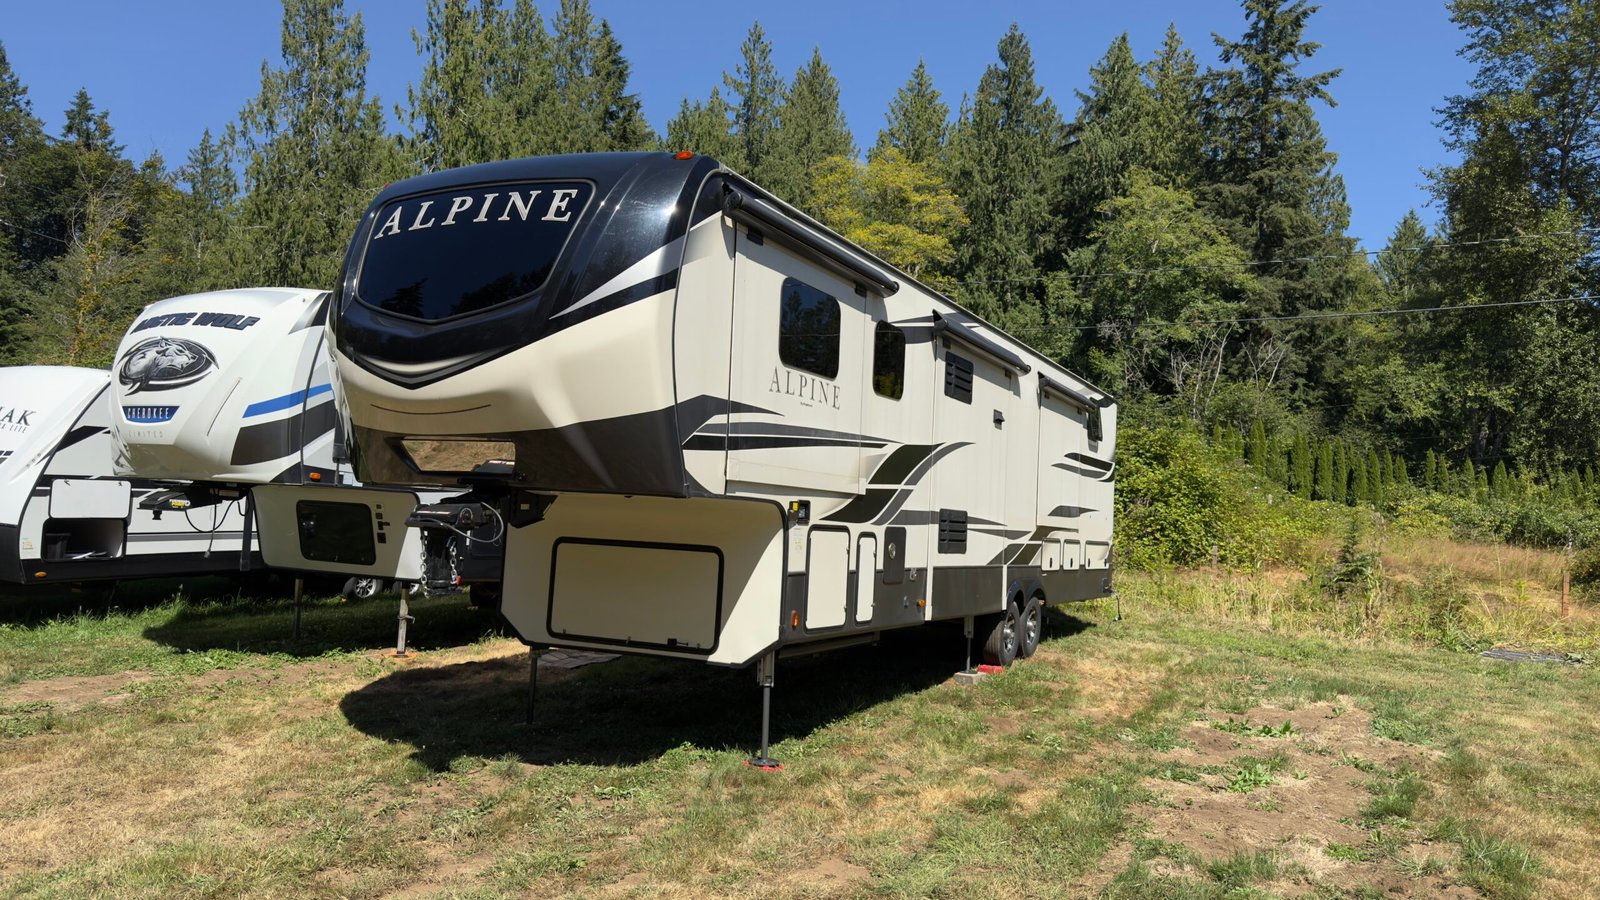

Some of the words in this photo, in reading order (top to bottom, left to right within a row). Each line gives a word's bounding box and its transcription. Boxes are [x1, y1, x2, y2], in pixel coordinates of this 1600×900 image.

[374, 189, 579, 240] ALPINE
[192, 312, 261, 331] WOLF
[769, 367, 841, 410] ALPINE
[0, 406, 36, 426] AK
[127, 407, 170, 419] CHEROKEE
